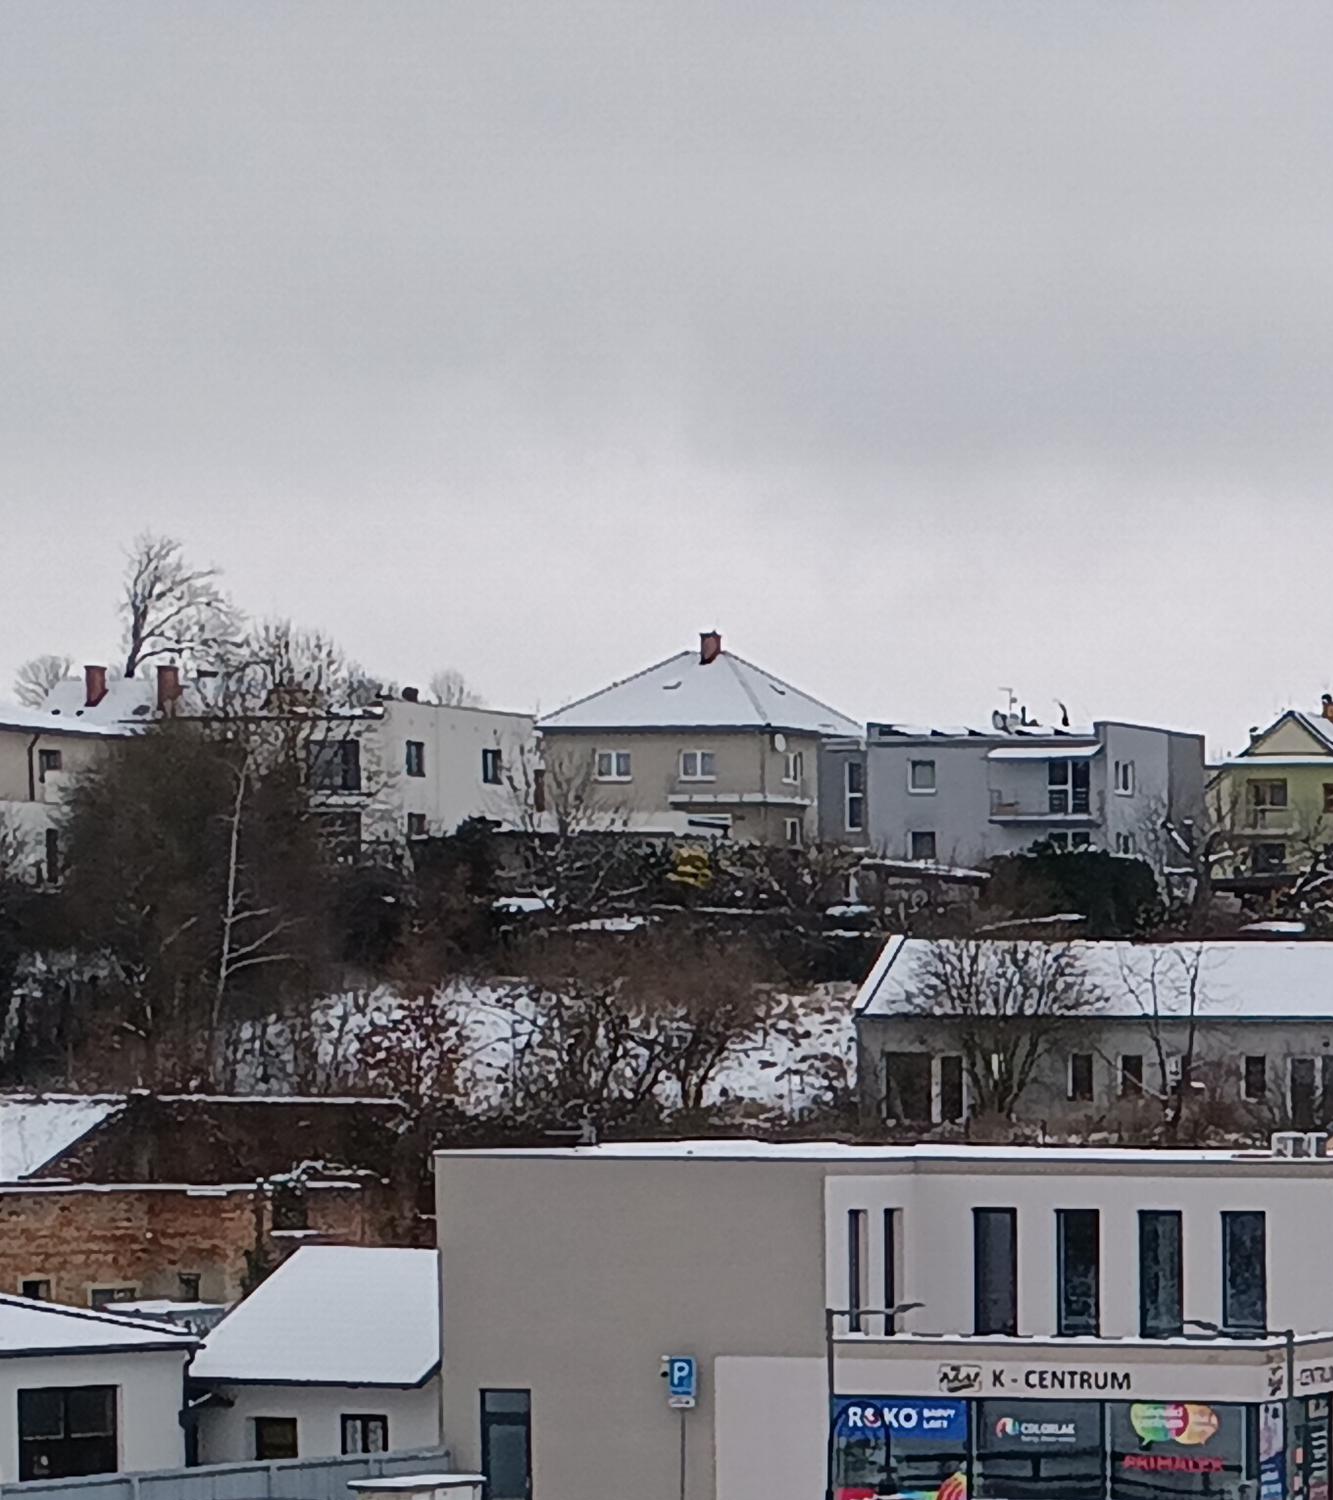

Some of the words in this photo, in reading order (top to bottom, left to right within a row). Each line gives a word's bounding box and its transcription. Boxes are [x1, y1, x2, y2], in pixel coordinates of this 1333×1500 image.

[673, 1361, 690, 1385] P
[992, 1369, 1005, 1388] K
[1024, 1369, 1132, 1390] CENTRUM
[1123, 1455, 1224, 1472] PRIMALEX
